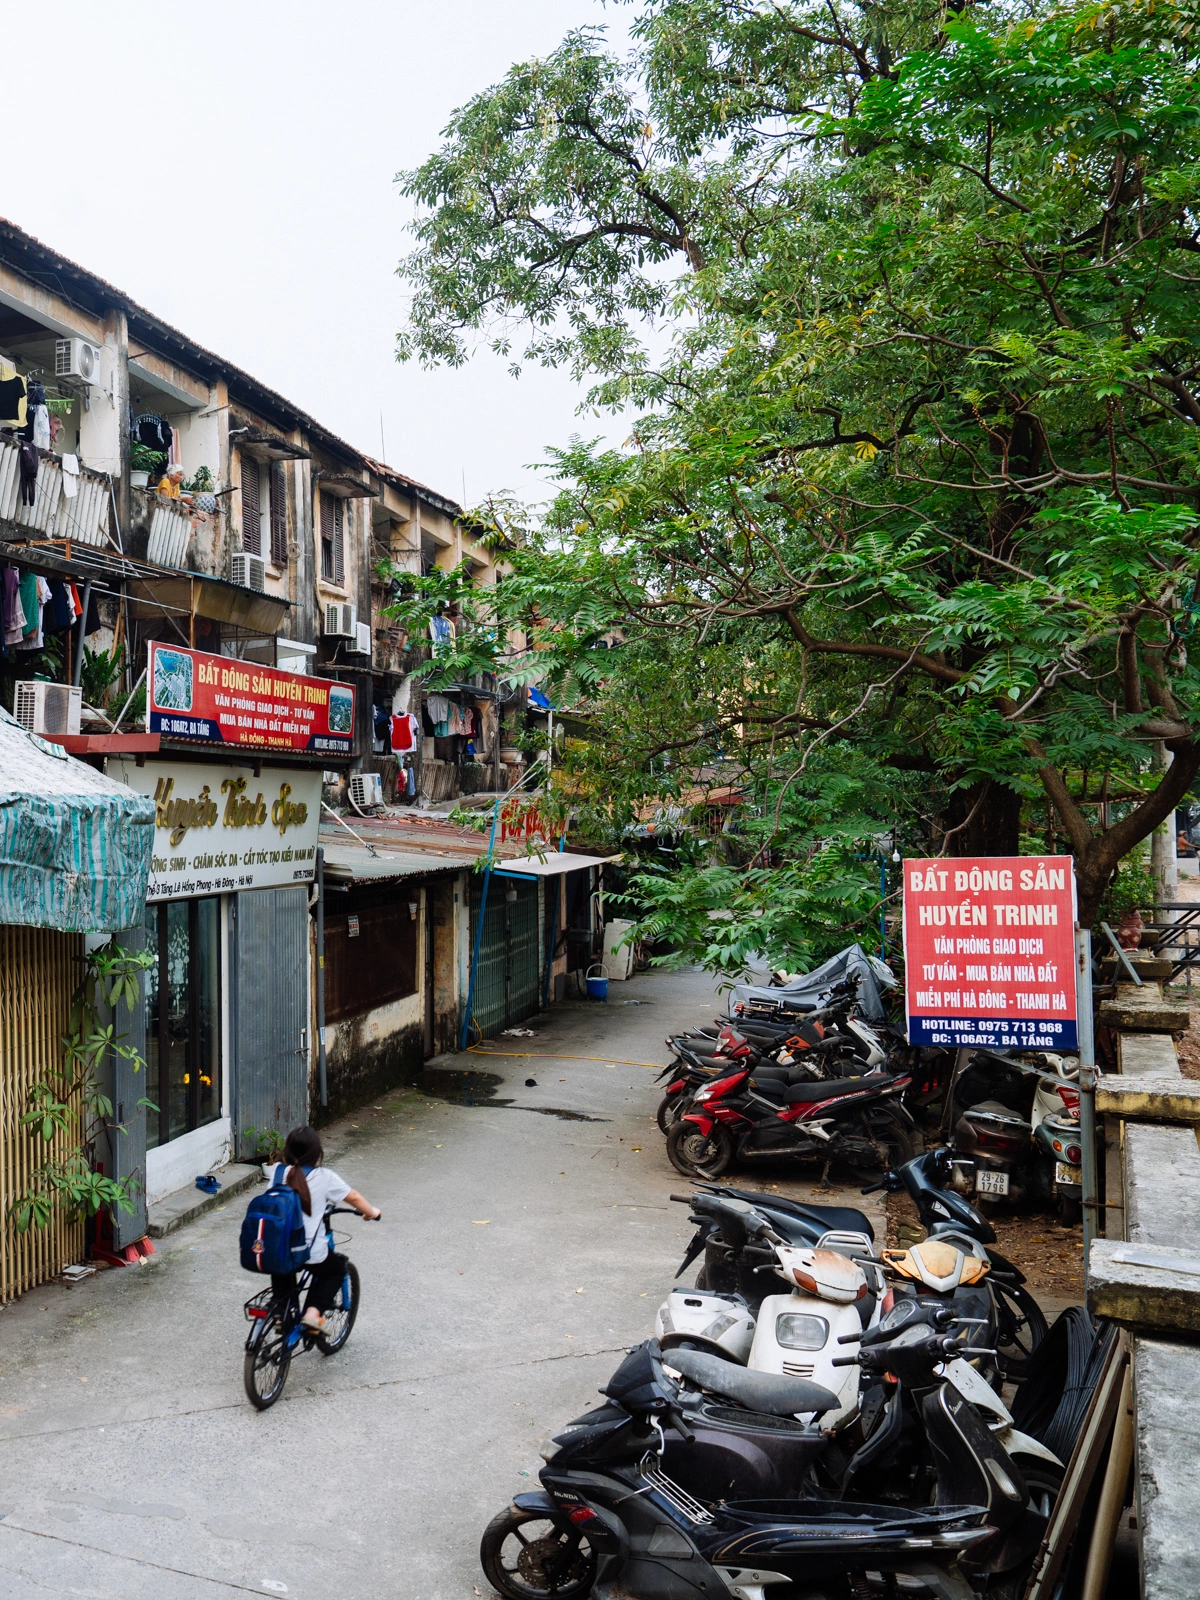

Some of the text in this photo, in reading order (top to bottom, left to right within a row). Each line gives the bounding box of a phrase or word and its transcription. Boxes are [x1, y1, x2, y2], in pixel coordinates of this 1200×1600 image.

[198, 660, 327, 706] BẤT ĐỘNG SẢN HUYỀN TRINH
[215, 693, 230, 707] VĂN
[232, 697, 256, 711] PHÒNG
[257, 702, 272, 714] GIAO
[274, 704, 288, 718] DỊCH
[294, 708, 302, 718] TƯ
[303, 707, 315, 720] VẤN
[190, 722, 196, 734] BA
[197, 719, 210, 736] TẦNG
[220, 713, 310, 736] MUA BÁN NHÀ ĐẤT MIỄN PHÍ
[240, 733, 248, 742] HÀ
[249, 733, 264, 744] ĐÔNG
[268, 736, 284, 746] THANH
[285, 737, 292, 748] HÀ
[153, 777, 308, 845] Huyền Trinh Spa
[150, 855, 167, 873] ỠNG
[170, 857, 186, 872] SINH
[193, 853, 213, 870] CHĂM
[214, 851, 227, 868] SÓC
[228, 854, 238, 866] DA
[244, 847, 255, 866] CẮT
[257, 849, 268, 864] TÓC
[270, 850, 280, 866] TẠO
[294, 849, 306, 862] NAM
[182, 879, 195, 894] Hồng
[196, 880, 212, 892] Phong
[222, 877, 234, 890] Đông
[238, 876, 245, 886] Hà
[910, 862, 1064, 896] BẤT ĐỘNG SẢN
[920, 899, 1058, 926] HUYỀN TRINH
[934, 935, 1043, 958] VĂN PHÒNG GIAO DỊCH
[923, 964, 936, 980] TƯ
[937, 960, 956, 980] VẤN
[966, 966, 988, 982] MUA
[990, 962, 1012, 982] BÁN
[1014, 963, 1035, 982] NHÀ
[1038, 960, 1058, 982] ĐẤT
[916, 986, 942, 1008] MIỄN
[944, 989, 960, 1008] PHÍ
[963, 989, 976, 1008] HÀ
[978, 990, 1006, 1008] ĐÔNG
[1016, 993, 1050, 1010] THANH
[1052, 991, 1066, 1010] HÀ
[922, 1020, 1062, 1033] HOTLINE: 0975 713 968
[932, 1034, 1054, 1046] ĐC: 106AT2, BA TẦNG
[982, 1172, 1004, 1184] 29-Z6
[982, 1182, 1004, 1193] 1796
[554, 1490, 579, 1500] HONDA
